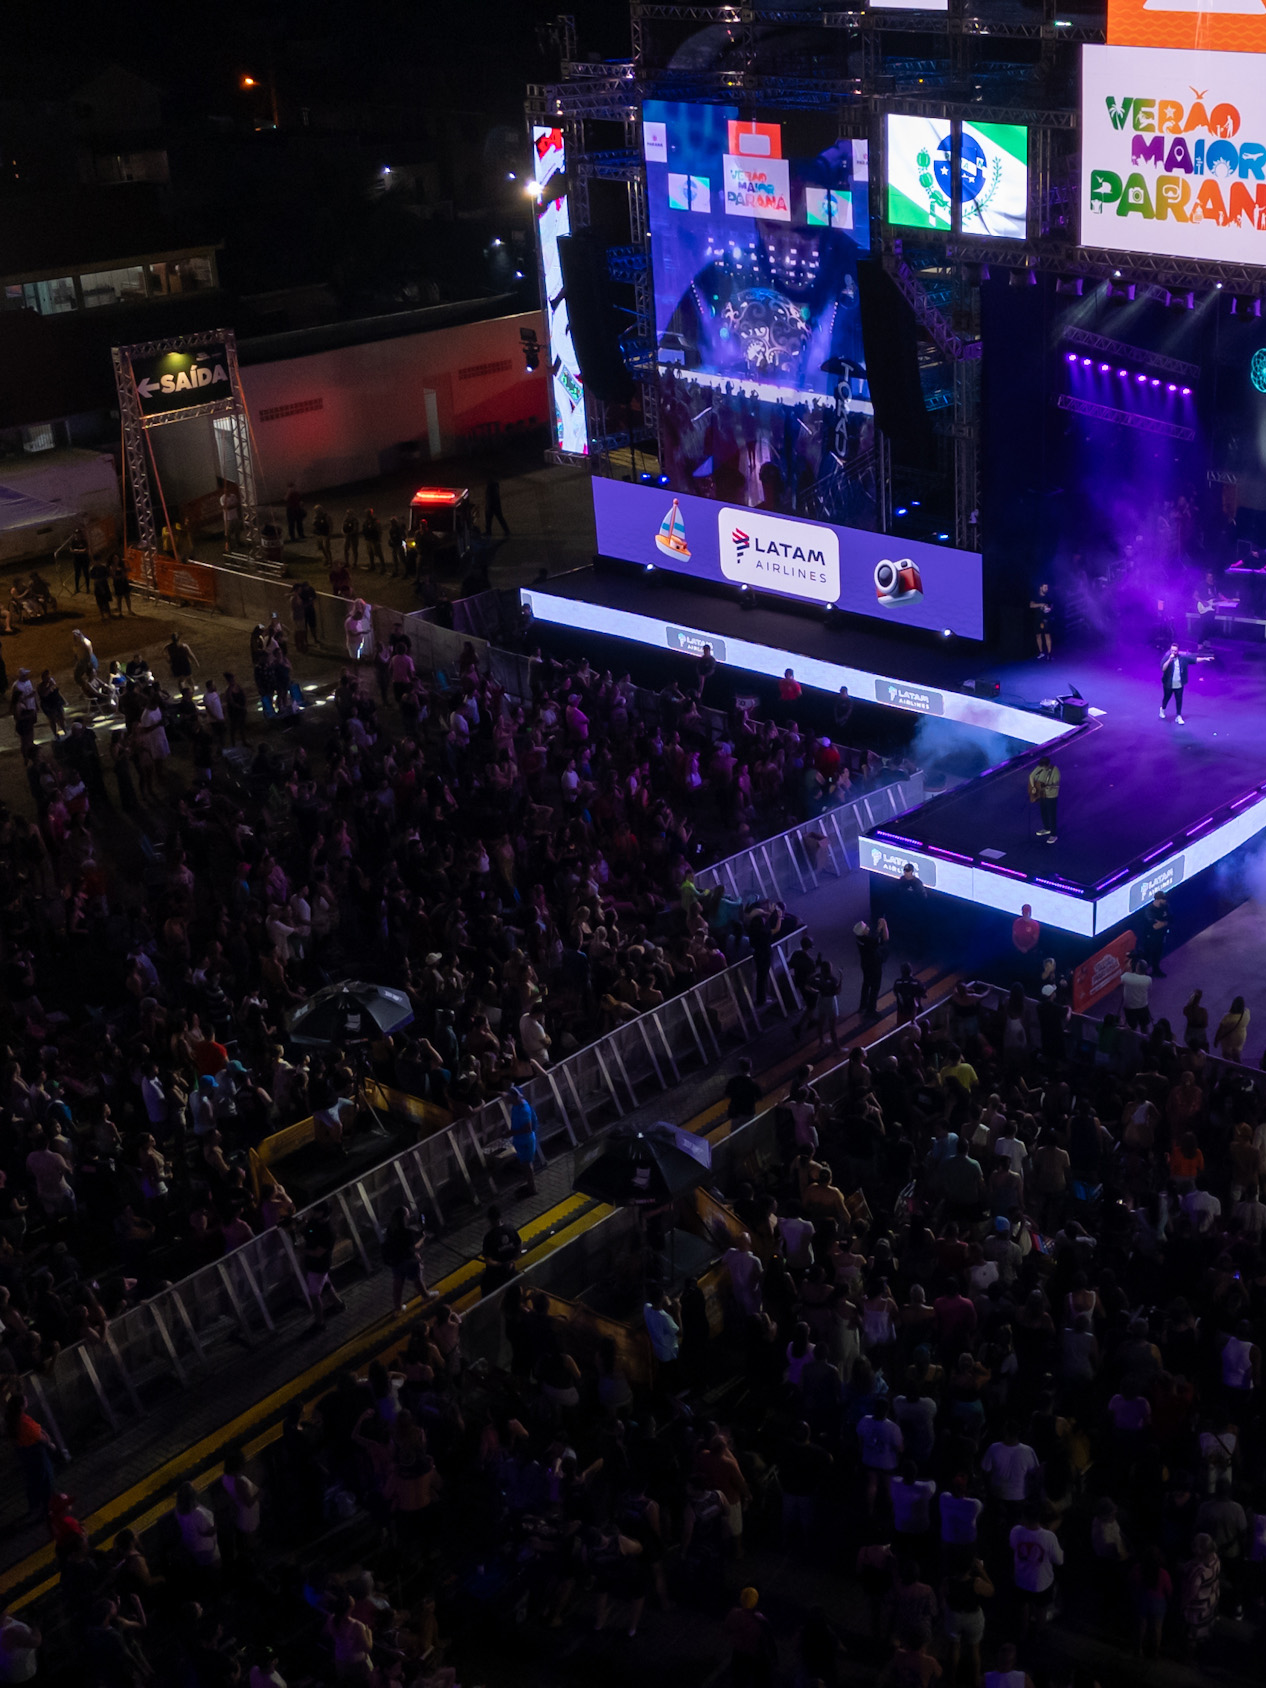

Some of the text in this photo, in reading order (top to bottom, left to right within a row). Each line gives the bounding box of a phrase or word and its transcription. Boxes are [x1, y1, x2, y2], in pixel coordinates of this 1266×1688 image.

[1105, 86, 1241, 139] VERÃO
[160, 363, 228, 394] SAÍDA
[755, 537, 825, 566] LATAM
[755, 560, 827, 583] AIRLINES
[898, 689, 930, 703] LATAM
